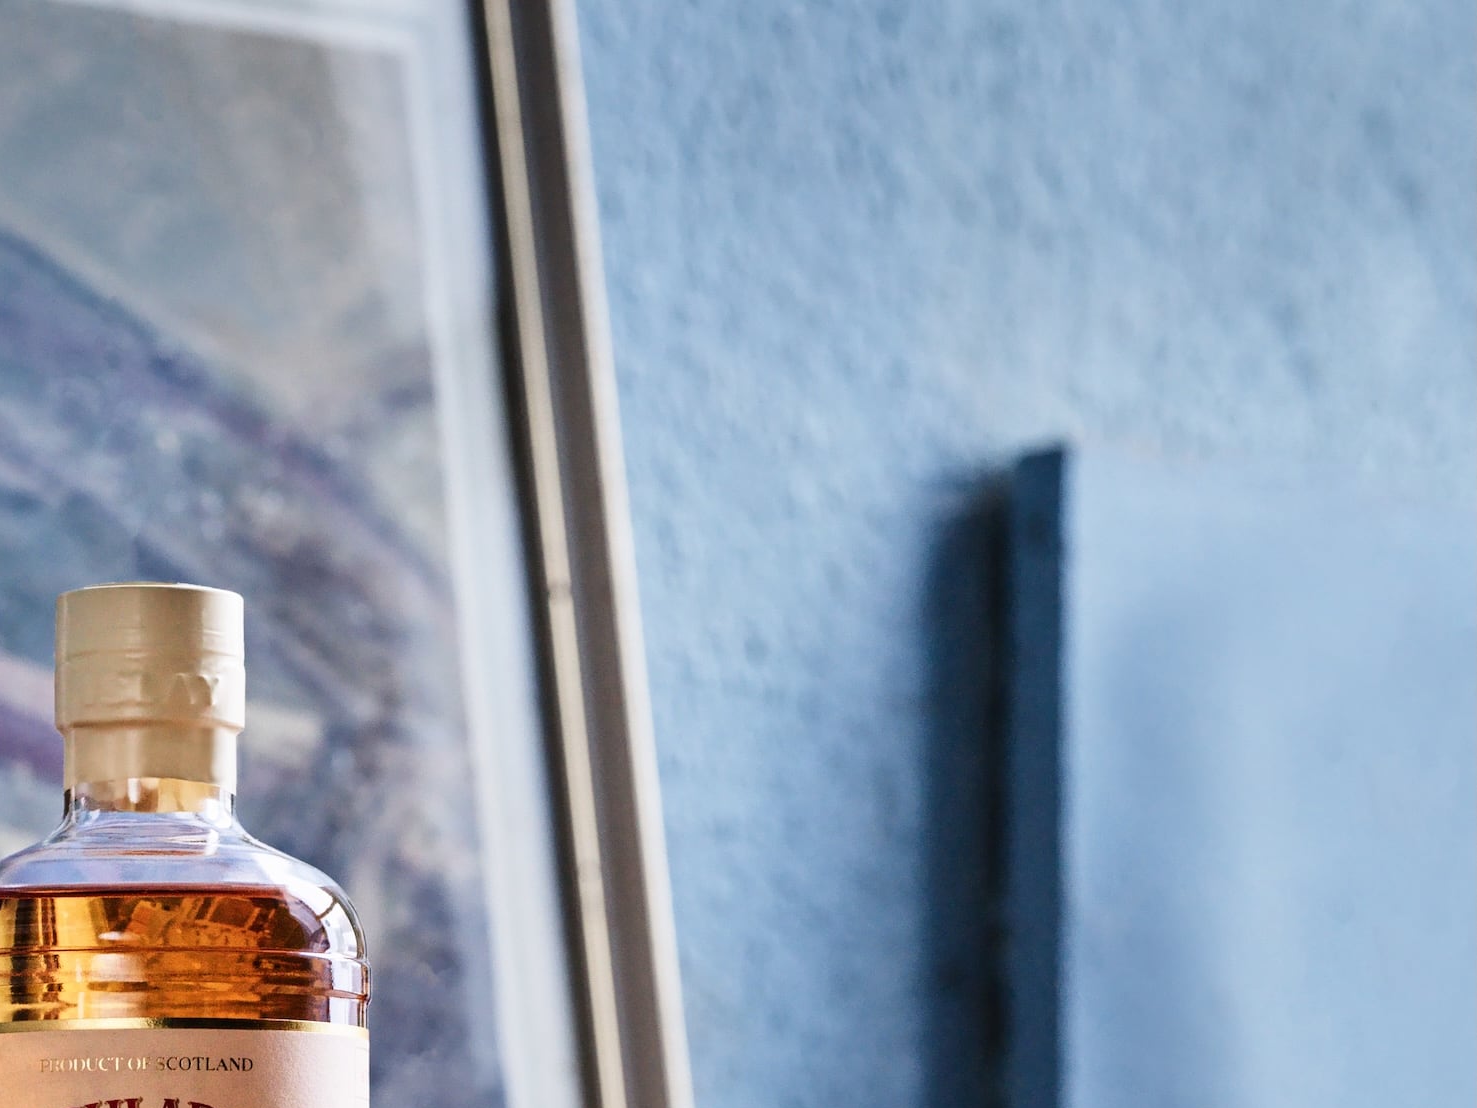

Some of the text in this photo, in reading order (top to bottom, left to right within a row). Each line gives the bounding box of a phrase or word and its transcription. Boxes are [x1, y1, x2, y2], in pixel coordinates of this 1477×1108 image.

[39, 1056, 254, 1073] PRODUCT OF SCOTLAND
